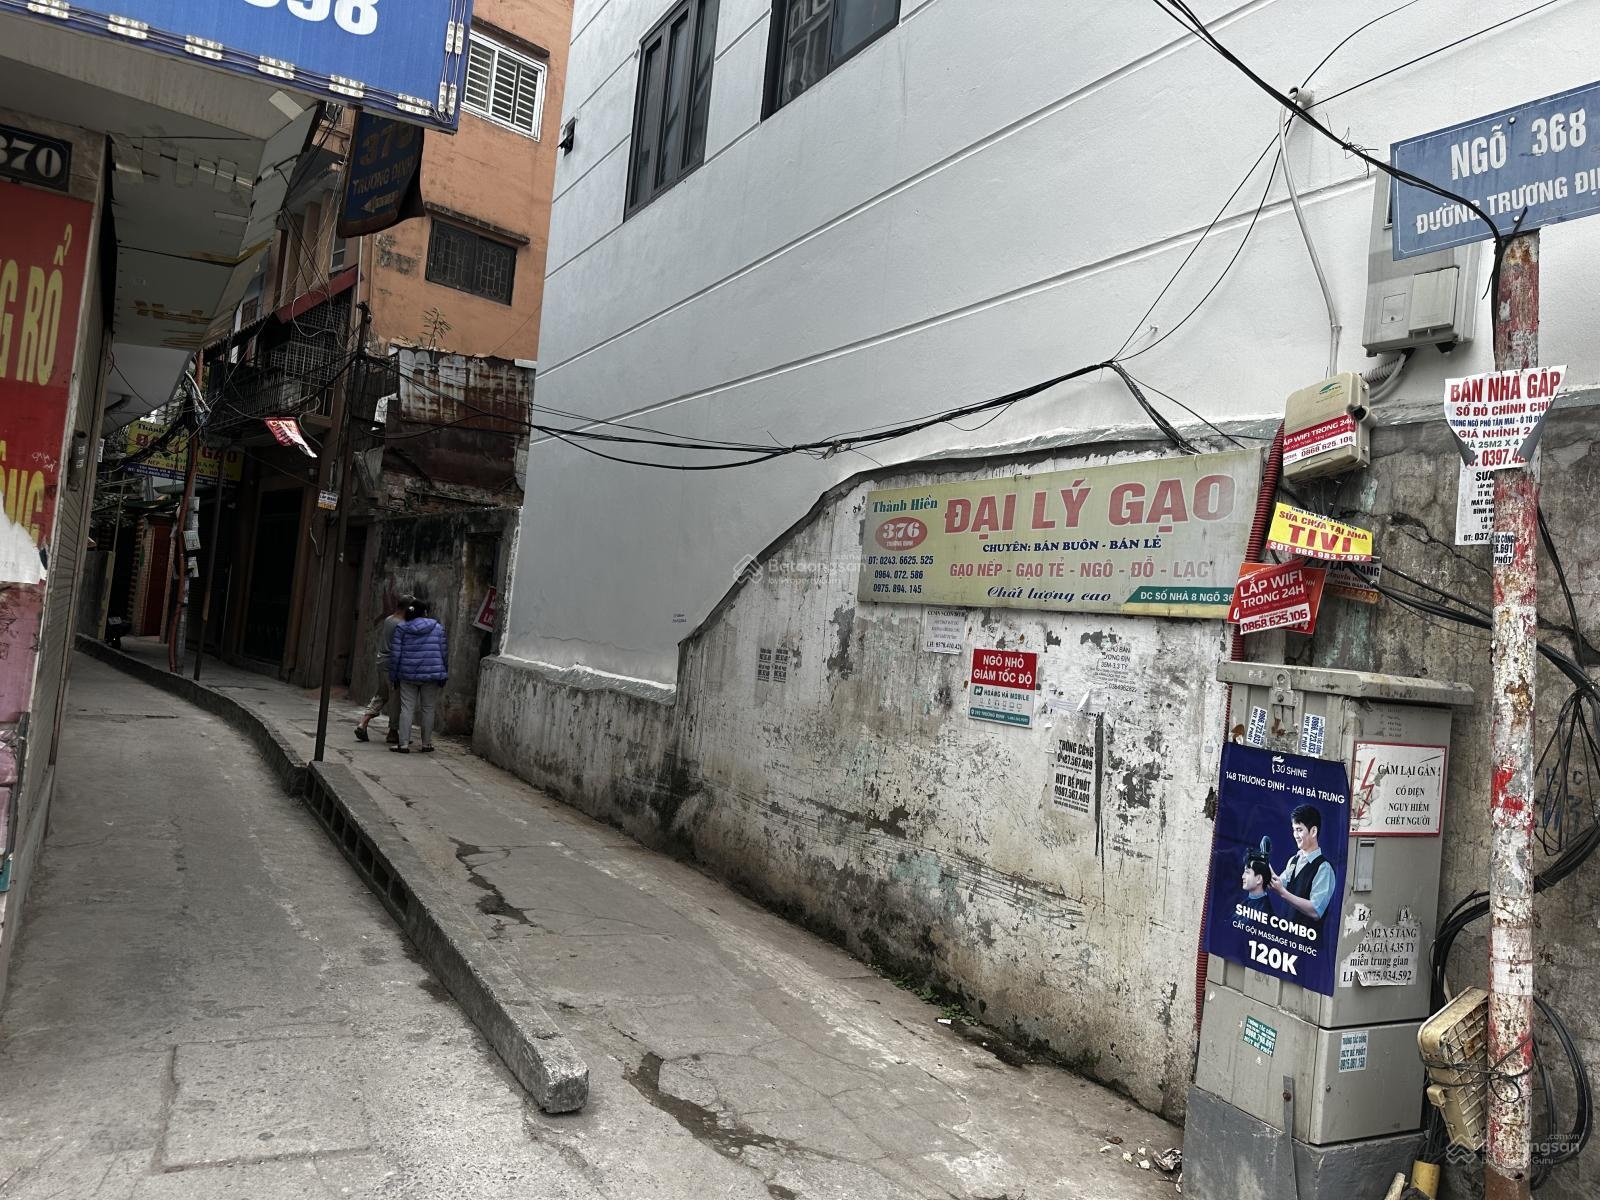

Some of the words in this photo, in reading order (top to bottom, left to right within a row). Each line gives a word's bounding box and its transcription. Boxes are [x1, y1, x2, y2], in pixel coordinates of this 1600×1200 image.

[1451, 123, 1507, 181] NGÕ
[1531, 107, 1587, 157] 368
[1487, 176, 1568, 216] TRƯƠNG
[1574, 167, 1600, 195] ĐỊ
[1450, 378, 1483, 402] BÁN
[1487, 371, 1521, 402] NHÀ
[1456, 403, 1471, 416] SỔ
[1473, 403, 1488, 416] ĐỎ
[1491, 402, 1526, 415] CHÍNH
[1459, 428, 1478, 438] GIÁ
[1462, 440, 1476, 449] HÀ
[1478, 440, 1502, 449] 25M2
[873, 499, 907, 513] Thành
[911, 494, 938, 511] Hiền
[944, 493, 1017, 541] ĐẠI
[1031, 478, 1092, 530] LÝ
[1108, 473, 1237, 534] GẠO
[882, 522, 920, 539] 376
[1289, 524, 1351, 552] TIVI
[1474, 532, 1489, 541] 037
[982, 540, 1031, 552] CHUYÊN:
[1033, 539, 1059, 552] BÁN
[1062, 539, 1099, 551] BUÔN
[1109, 538, 1140, 550] BÁN
[920, 555, 934, 565] 525
[950, 563, 974, 579] GẠO
[977, 558, 1003, 577] NẾP
[1016, 562, 1044, 580] GẠO
[1080, 559, 1114, 578] NGÔ
[1240, 577, 1267, 597] LẮP
[1270, 570, 1303, 589] WIFI
[987, 586, 1024, 598] Chất
[1028, 587, 1075, 602] lượng
[1081, 593, 1111, 601] cao
[1155, 589, 1168, 601] SỐ
[1191, 593, 1197, 601] 8
[1200, 591, 1221, 602] NGÕ
[1223, 593, 1233, 602] 36
[1241, 591, 1279, 608] TRONG
[1282, 584, 1304, 599] 24H
[1241, 609, 1307, 632] 0868.625.106
[983, 653, 1003, 666] NGÕ
[1005, 654, 1025, 668] NHỎ
[998, 667, 1016, 683] TỐC
[1018, 671, 1032, 688] ĐỘ
[1401, 766, 1415, 778] LẠI
[1226, 771, 1237, 781] 148
[1238, 773, 1266, 787] TRƯƠNG
[1267, 780, 1285, 791] ĐỊNH
[1292, 785, 1305, 796] HAI
[1306, 787, 1316, 798] BÀ
[1318, 790, 1345, 804] TRƯNG
[1395, 785, 1406, 796] CÓ
[1407, 786, 1425, 798] ĐIỆN
[1389, 803, 1409, 812] NGUY
[1235, 903, 1268, 925] SHINE
[1270, 916, 1317, 941] COMBO
[1258, 930, 1288, 946] MASSAGE
[1289, 940, 1297, 949] 10
[1248, 940, 1298, 976] 120K
[1350, 954, 1369, 966] miễn
[1370, 957, 1392, 968] trung
[1393, 956, 1409, 968] gian
